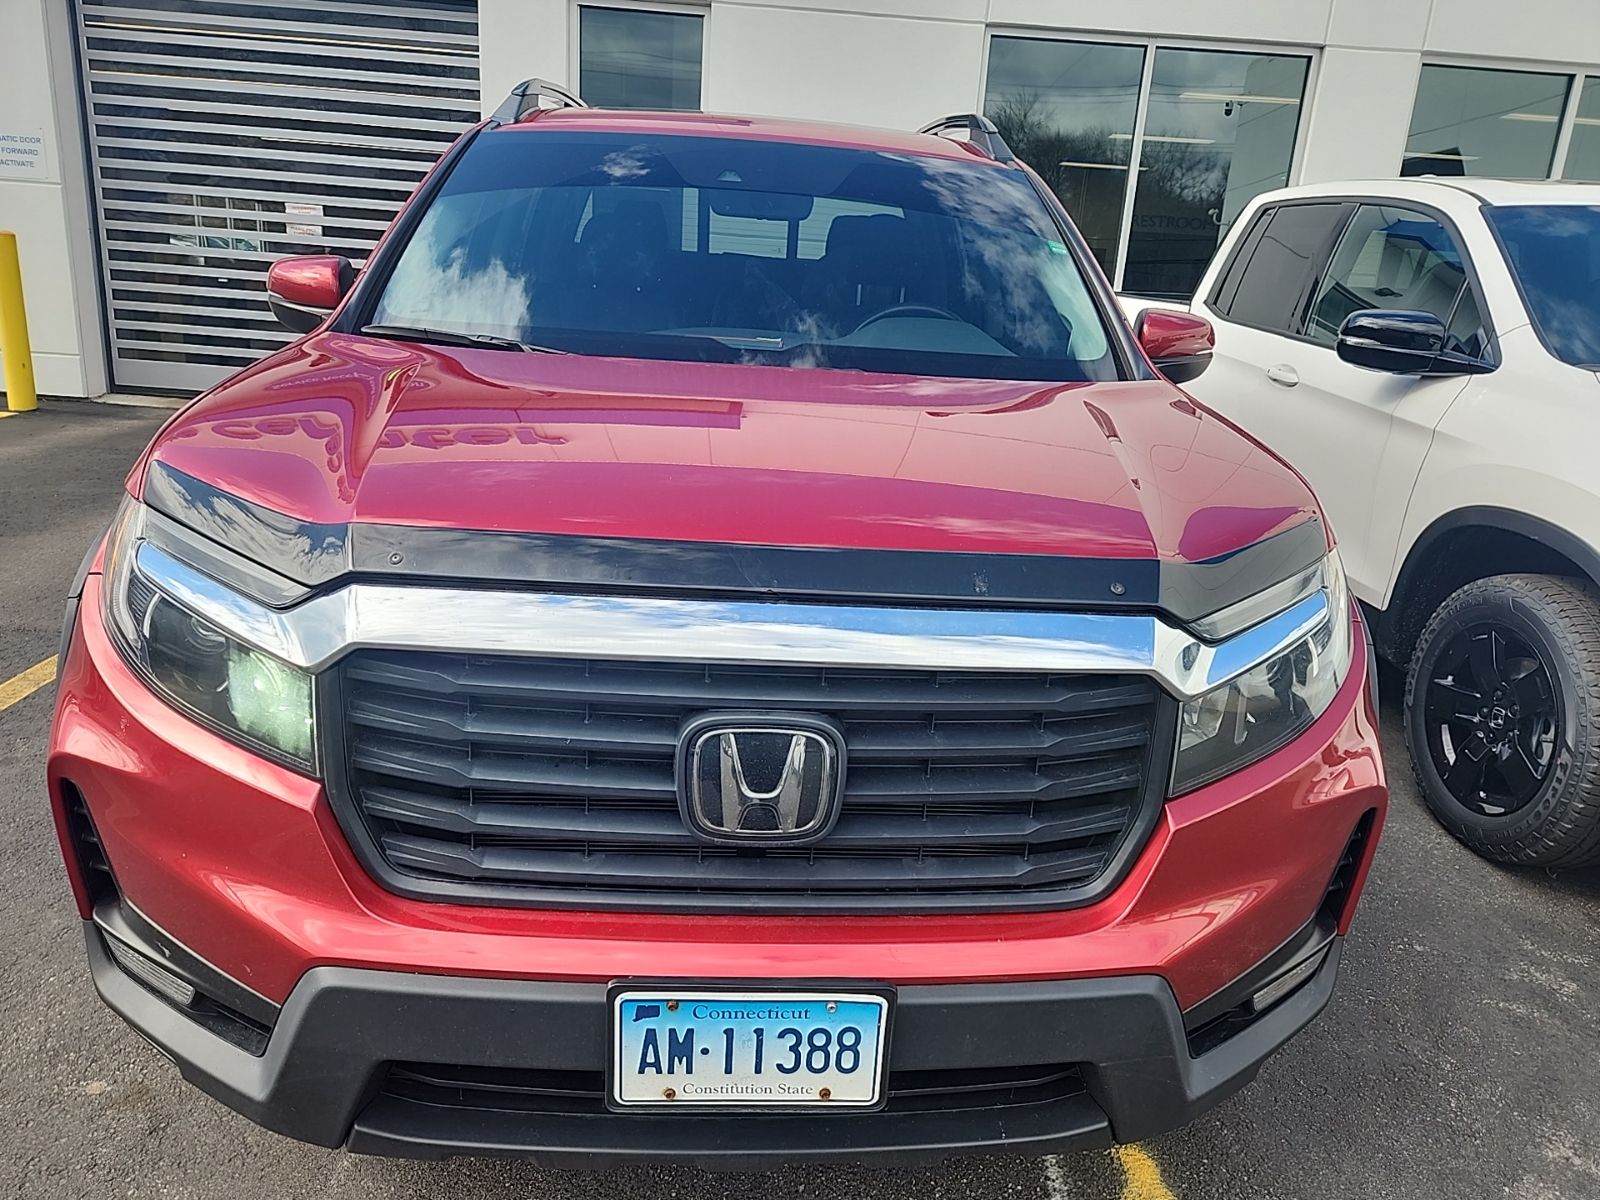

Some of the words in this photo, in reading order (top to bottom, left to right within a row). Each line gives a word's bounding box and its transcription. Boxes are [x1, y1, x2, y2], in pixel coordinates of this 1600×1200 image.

[19, 136, 42, 144] DOOR
[1, 147, 39, 156] FORWARD
[692, 1004, 812, 1021] Connecticut
[682, 1082, 773, 1095] Constitution
[777, 1082, 814, 1096] State
